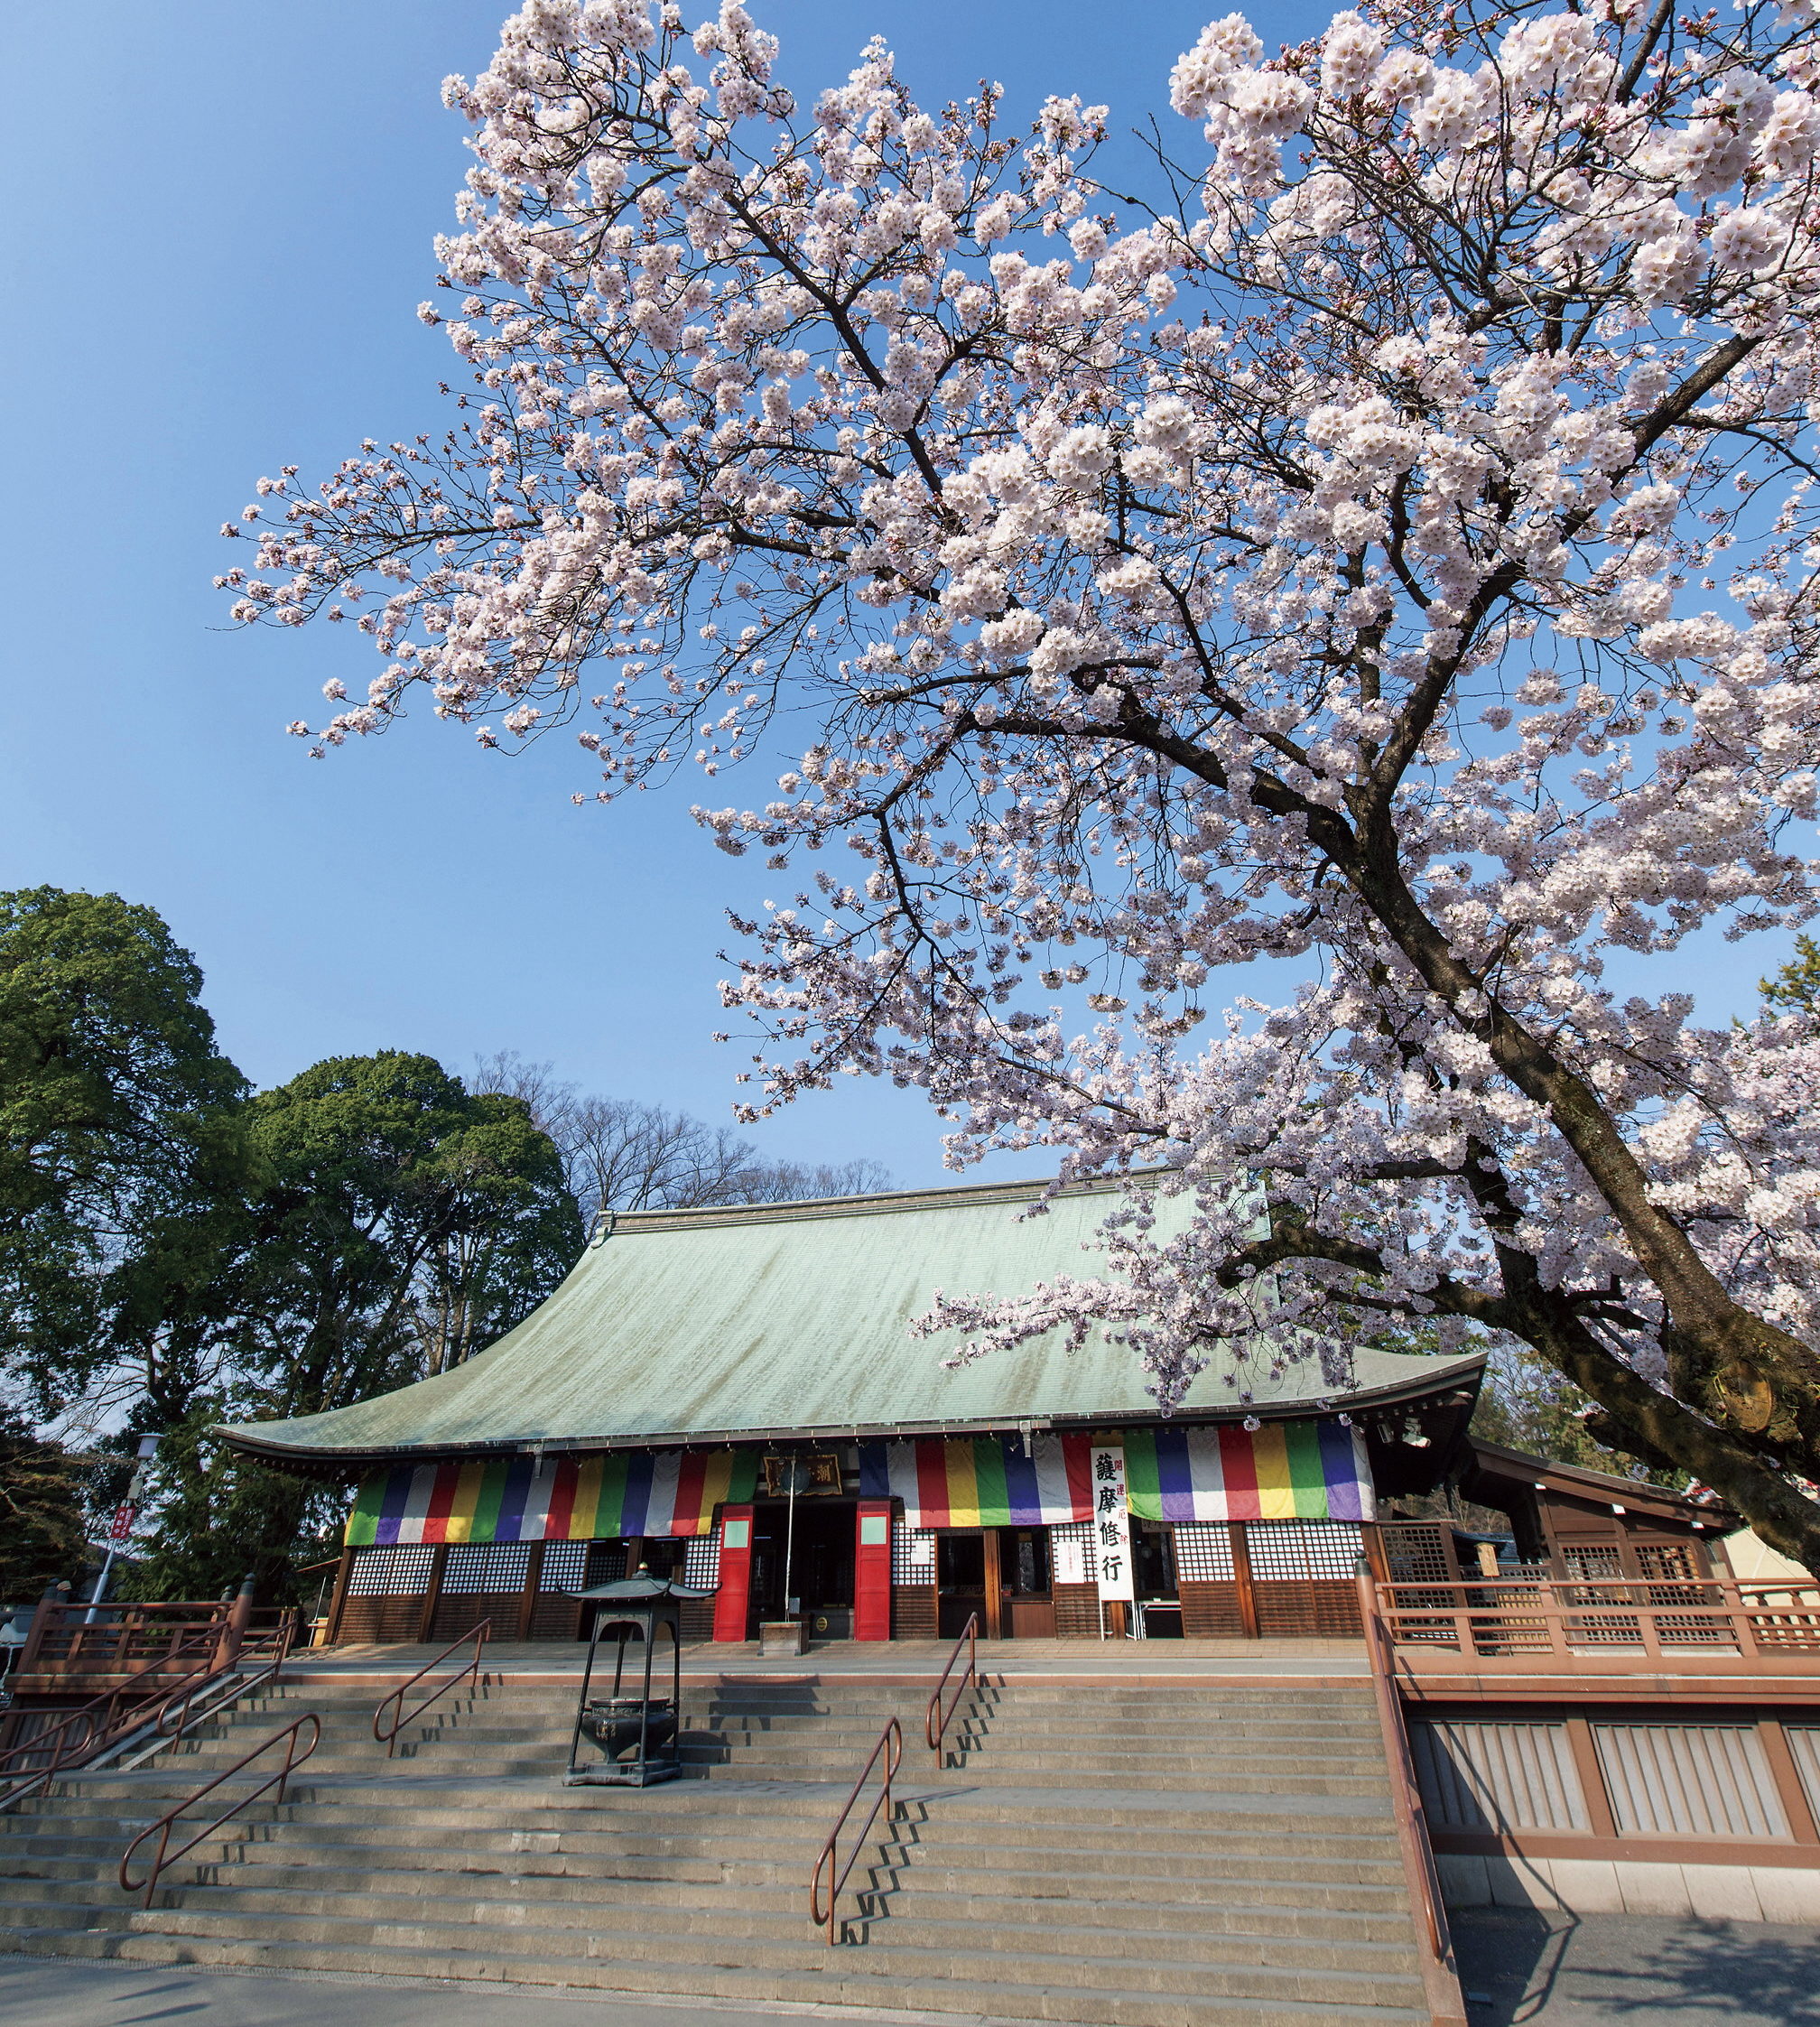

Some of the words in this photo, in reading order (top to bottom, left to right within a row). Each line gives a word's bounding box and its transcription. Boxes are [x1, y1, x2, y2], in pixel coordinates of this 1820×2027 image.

[1095, 1452, 1123, 1582] 護摩修行
[1114, 1459, 1128, 1545] 開運厄除
